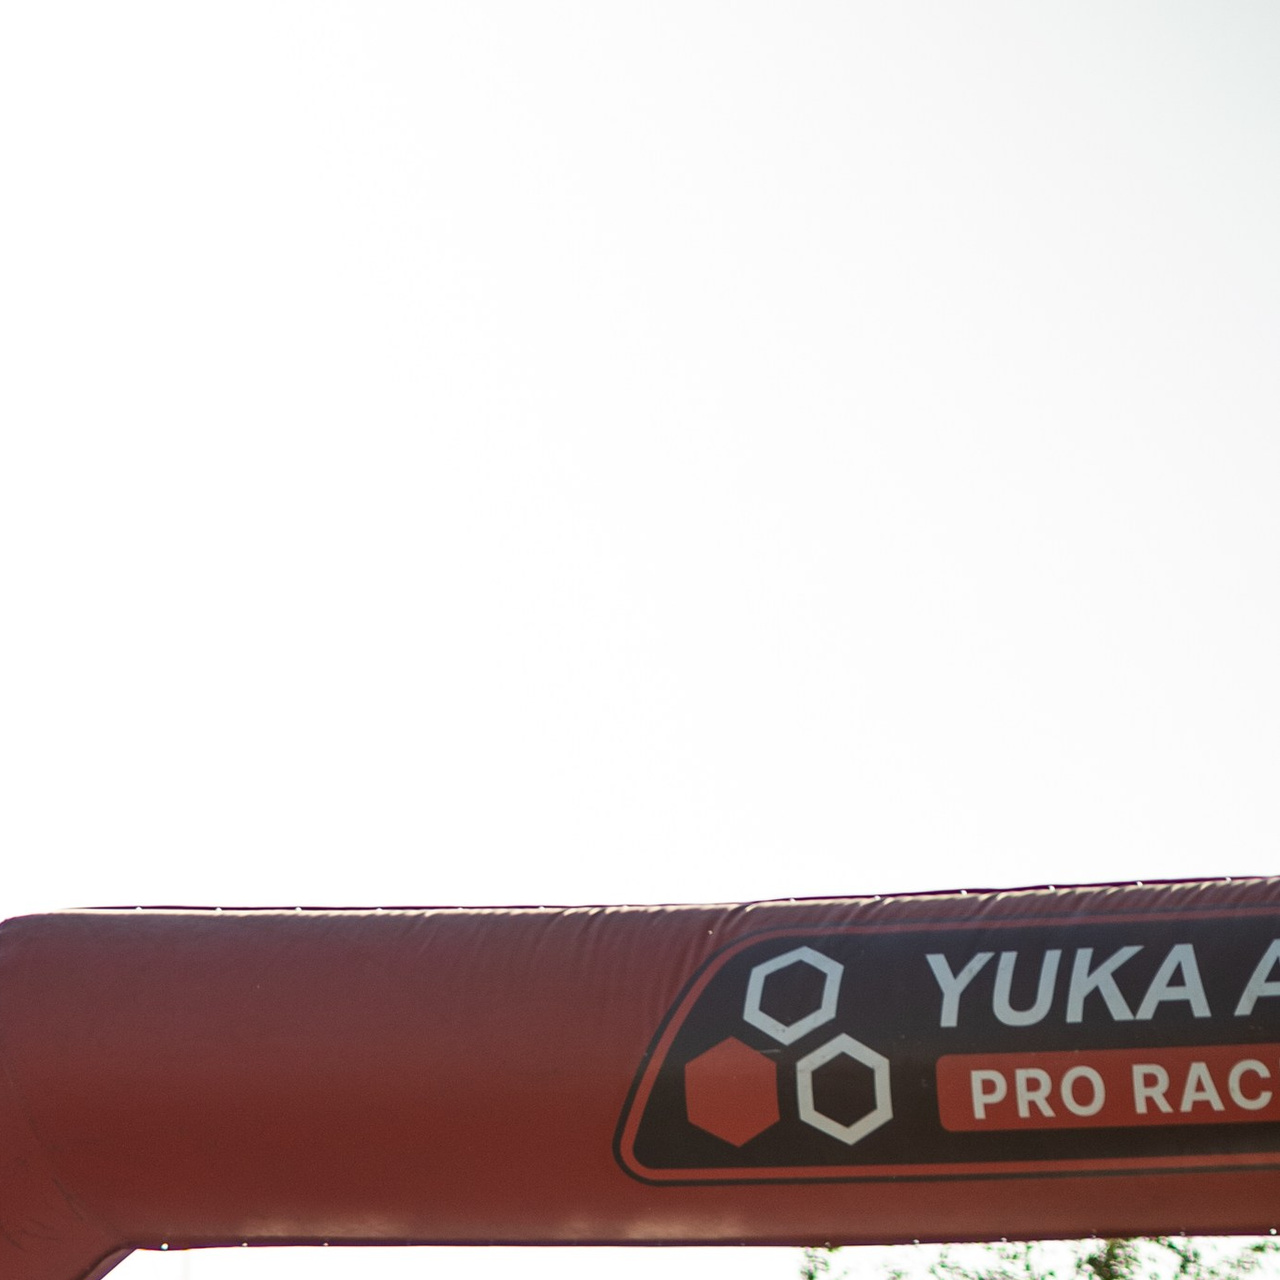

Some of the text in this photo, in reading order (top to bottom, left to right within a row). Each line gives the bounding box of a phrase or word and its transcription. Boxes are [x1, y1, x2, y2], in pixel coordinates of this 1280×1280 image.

[926, 943, 1212, 1028] YUKA
[969, 1059, 1280, 1120] PRO RAC
